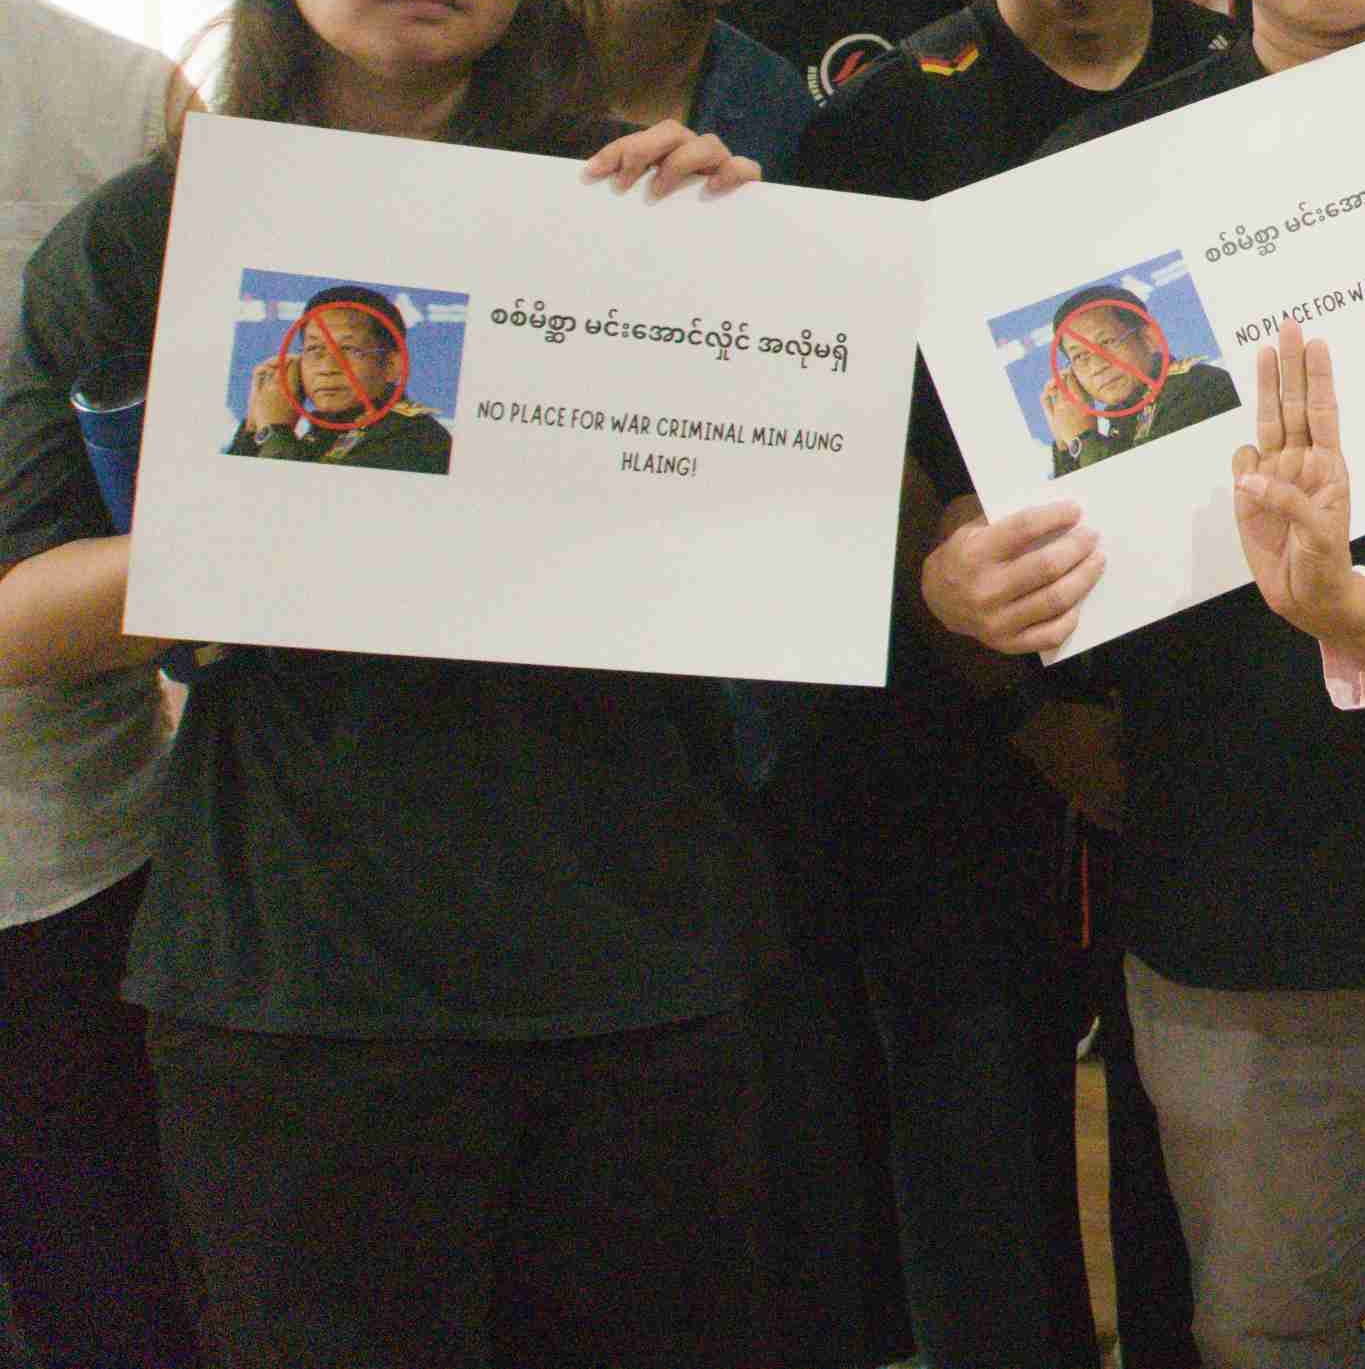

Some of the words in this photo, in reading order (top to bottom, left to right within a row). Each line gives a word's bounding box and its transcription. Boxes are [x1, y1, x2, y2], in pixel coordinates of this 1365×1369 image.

[1236, 324, 1260, 346] NO
[1314, 291, 1346, 316] FOR
[477, 401, 504, 421] NO
[510, 403, 566, 427] PLACE
[571, 408, 605, 430] FOR
[611, 413, 650, 434] WAR
[656, 417, 744, 443] CRIMINAL
[752, 427, 787, 446] MIN
[792, 429, 843, 452] AUNG
[622, 452, 696, 476] HLAING!
